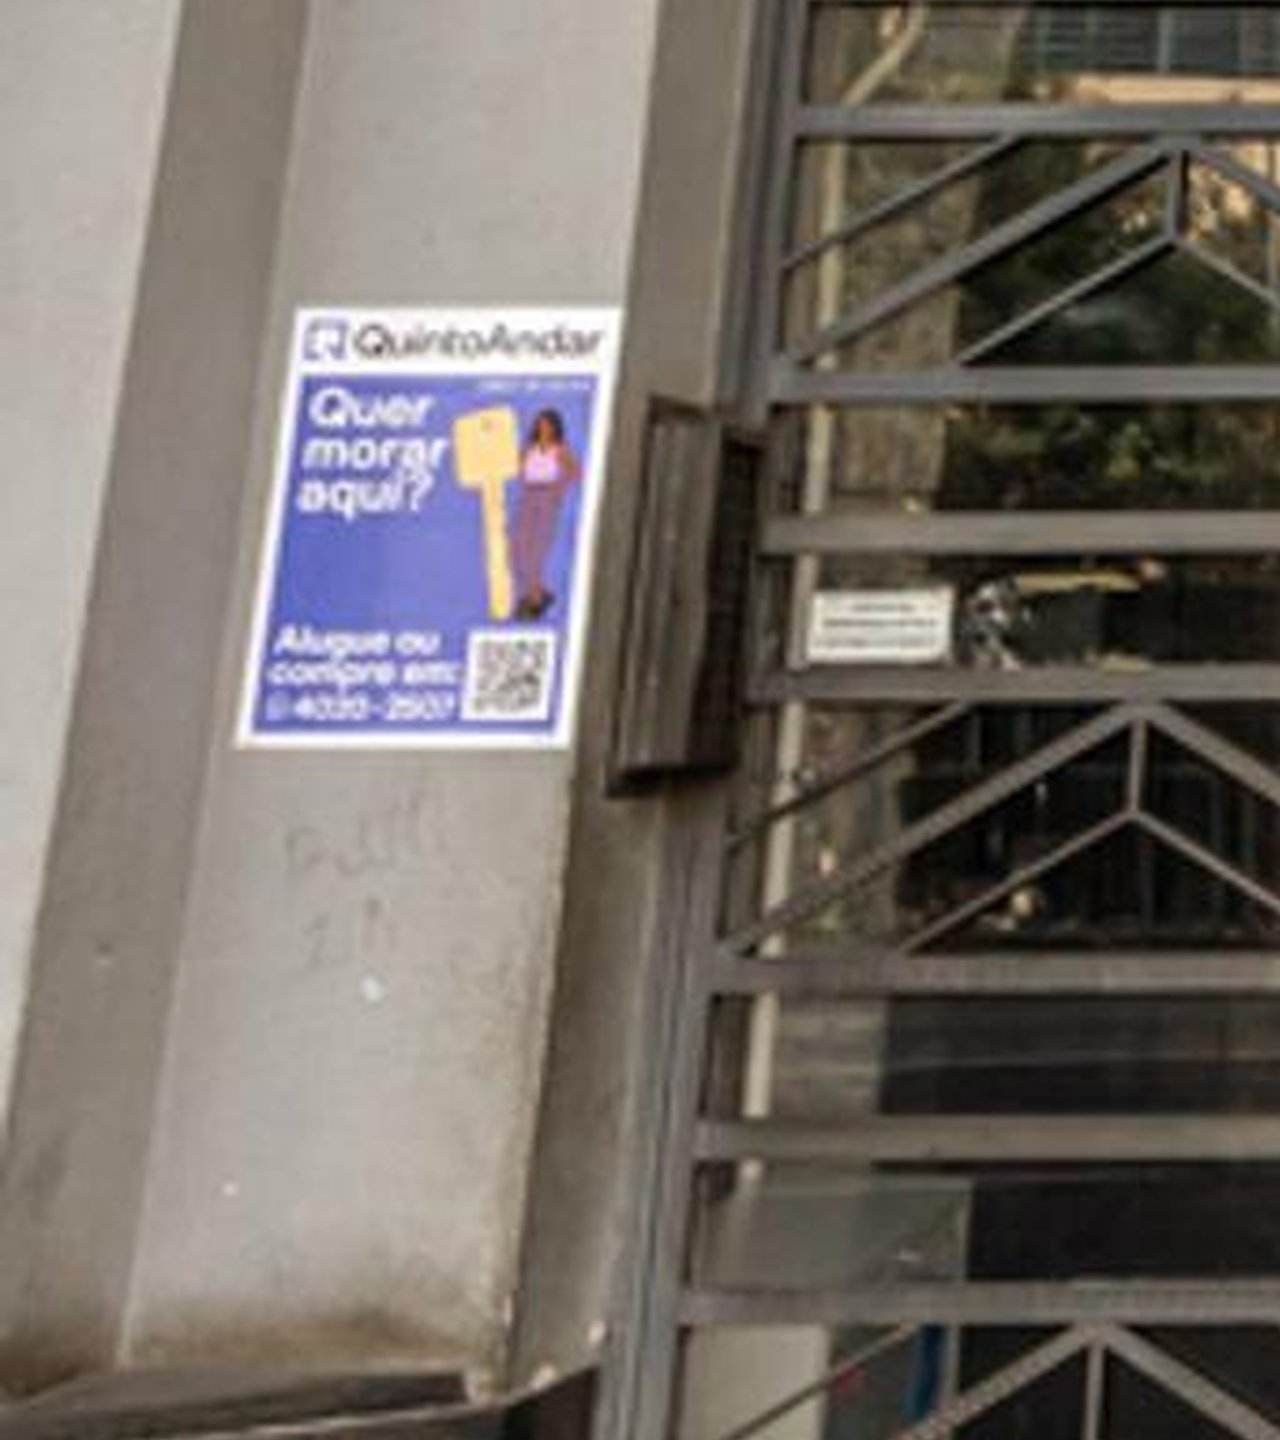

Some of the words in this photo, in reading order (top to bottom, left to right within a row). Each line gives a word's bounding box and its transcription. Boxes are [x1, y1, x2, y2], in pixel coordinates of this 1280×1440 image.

[353, 322, 602, 360] QuintoAndar
[307, 387, 434, 428] Quer
[301, 437, 450, 470] morar
[297, 466, 434, 520] aqui?
[272, 624, 390, 662] Alugue
[394, 631, 442, 656] ou
[268, 660, 396, 697] compre
